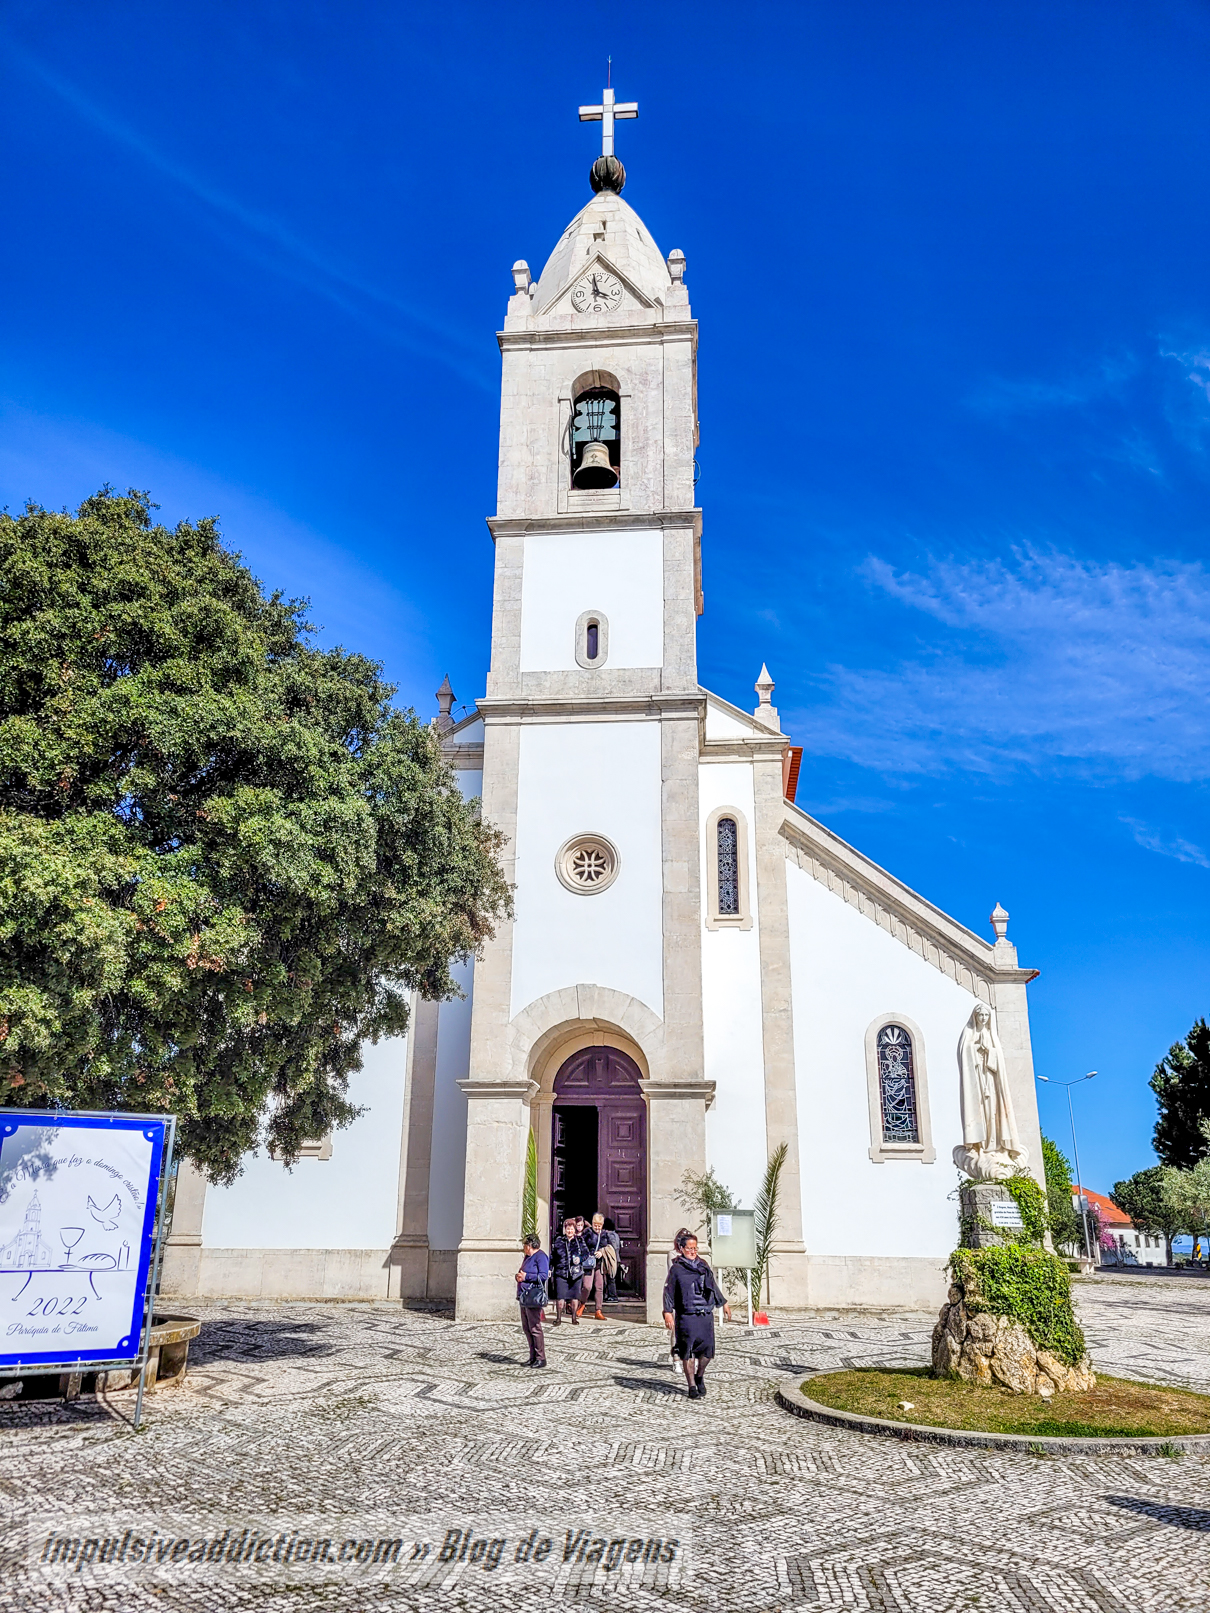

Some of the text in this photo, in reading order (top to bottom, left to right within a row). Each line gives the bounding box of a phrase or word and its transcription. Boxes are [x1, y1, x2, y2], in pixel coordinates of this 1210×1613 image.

[610, 289, 621, 297] 3
[593, 303, 602, 312] 6
[10, 1182, 16, 1190] a
[16, 1161, 51, 1181] Missa
[52, 1156, 68, 1169] que
[67, 1153, 83, 1168] faz
[93, 1158, 123, 1179] domingo
[25, 1296, 88, 1317] 2022
[5, 1320, 99, 1338] Paróquia de Fátima
